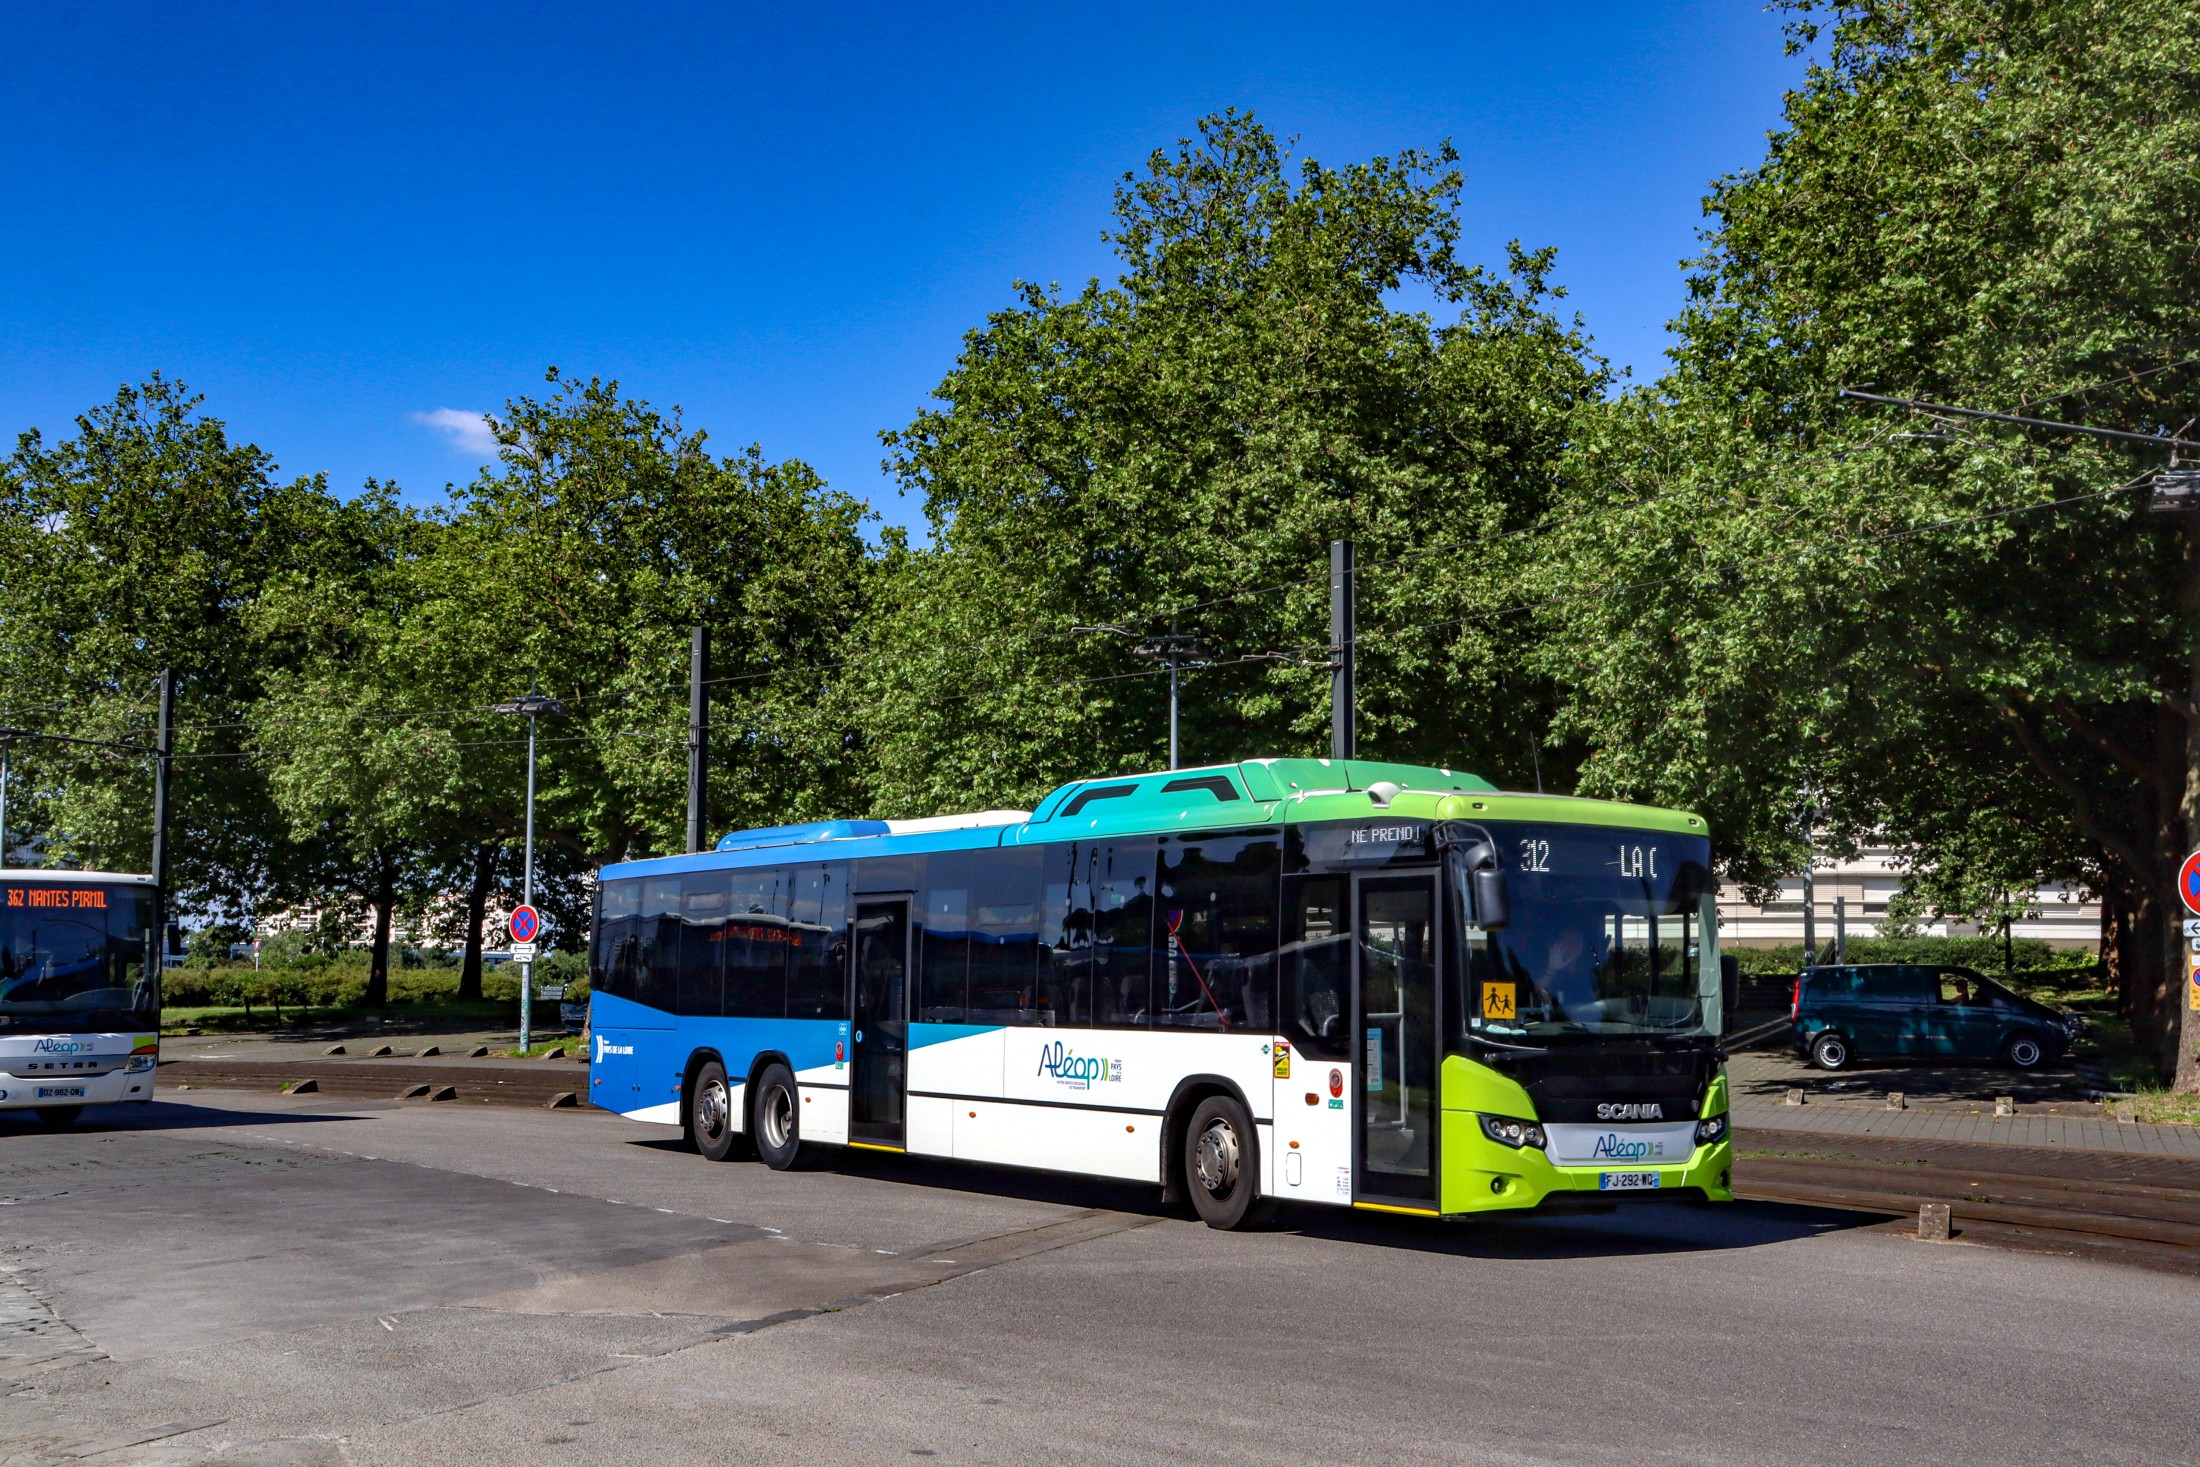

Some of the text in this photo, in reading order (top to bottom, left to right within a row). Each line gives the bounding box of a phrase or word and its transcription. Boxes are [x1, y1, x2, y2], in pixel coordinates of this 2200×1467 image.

[1351, 829, 1367, 843] NE
[1520, 838, 1550, 873] 312
[1620, 845, 1643, 878] LA
[7, 889, 107, 908] 362 NANTES PIRMIL
[28, 1061, 98, 1070] SETRA
[1596, 1103, 1664, 1119] SCANIA
